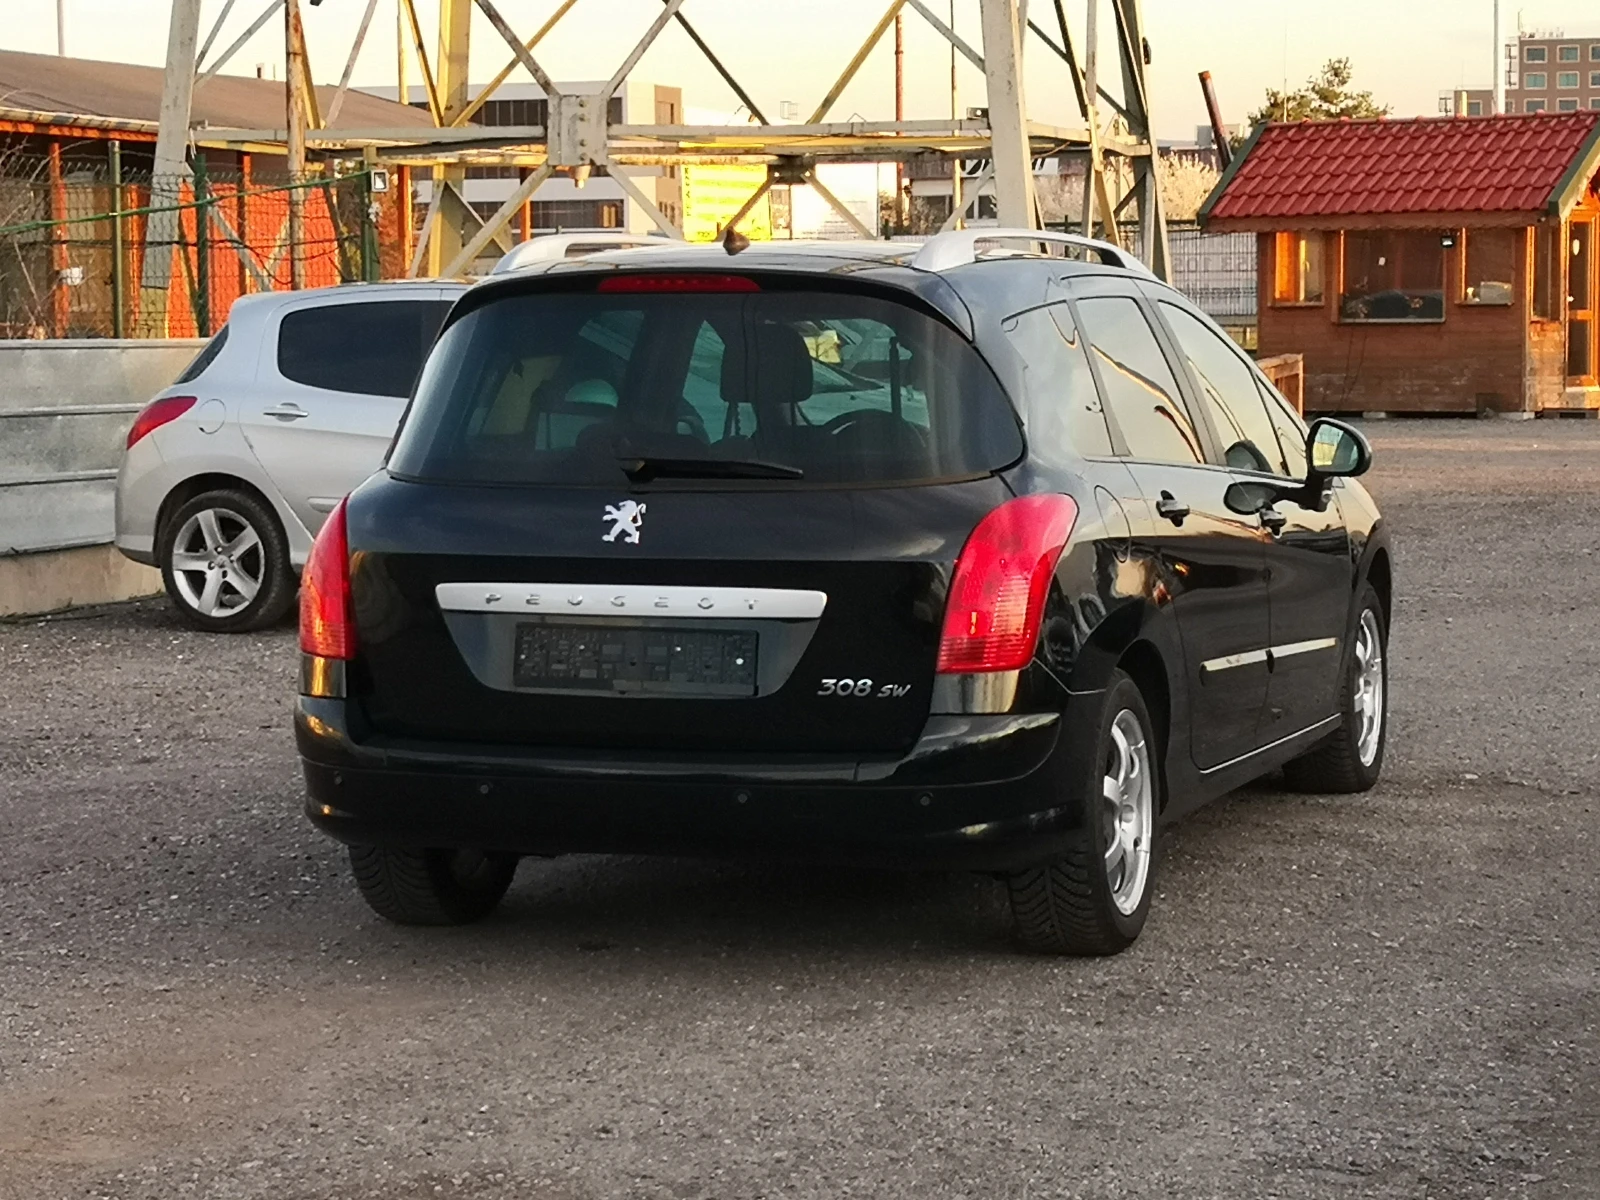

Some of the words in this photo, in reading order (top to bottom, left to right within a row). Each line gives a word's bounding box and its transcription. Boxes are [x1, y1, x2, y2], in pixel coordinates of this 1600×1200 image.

[485, 593, 760, 611] PEUGEOT
[817, 678, 873, 697] 308
[877, 684, 911, 697] SW
